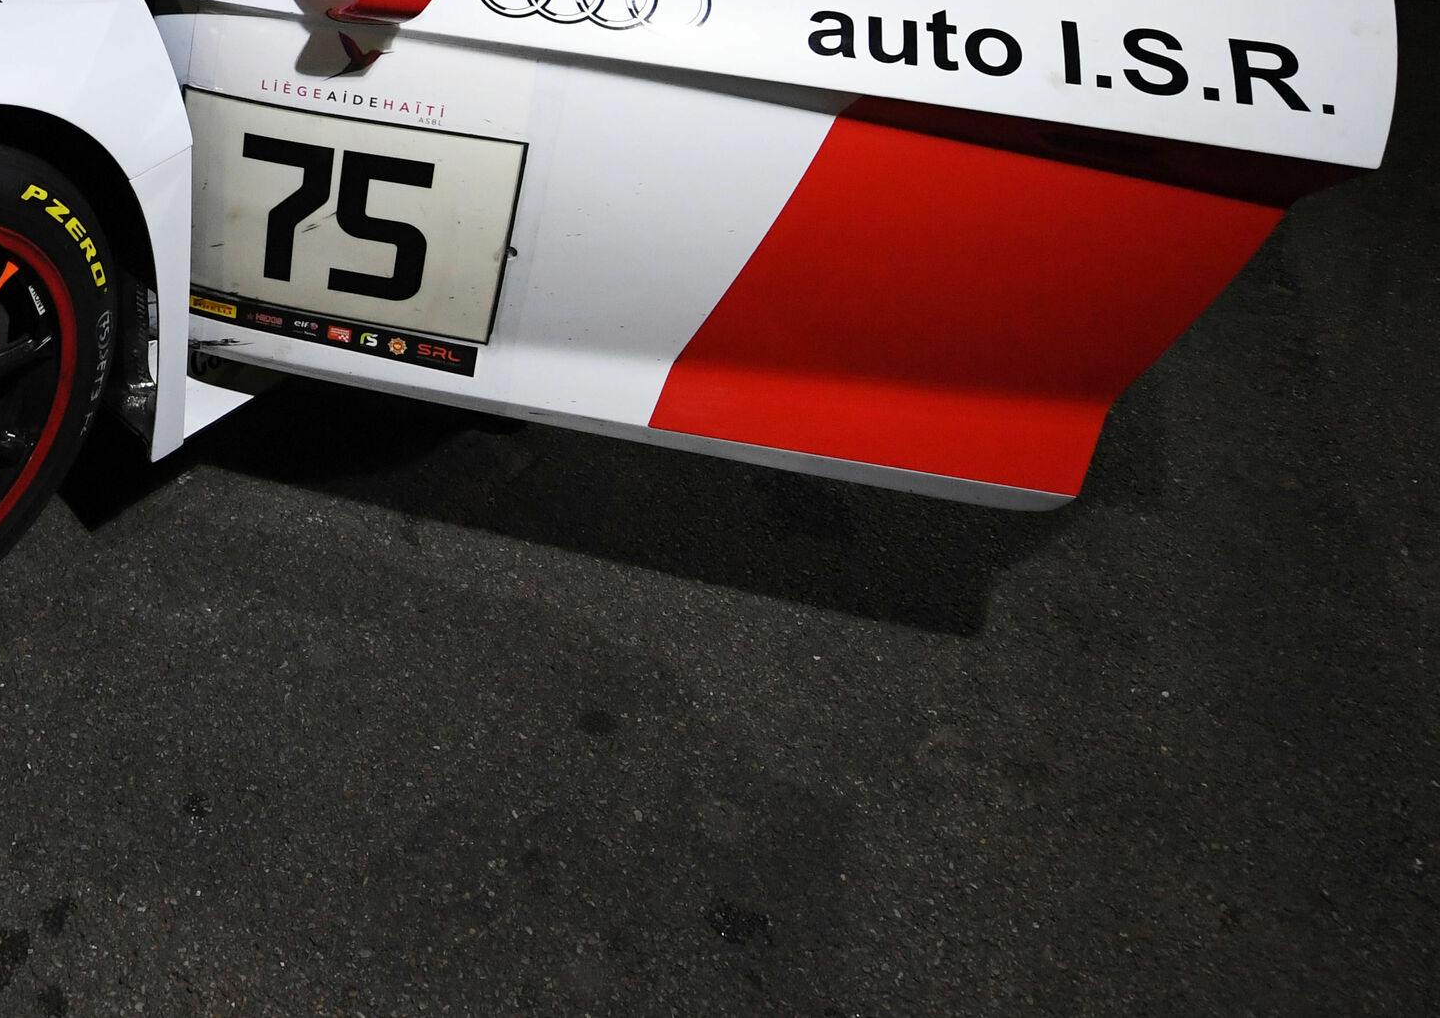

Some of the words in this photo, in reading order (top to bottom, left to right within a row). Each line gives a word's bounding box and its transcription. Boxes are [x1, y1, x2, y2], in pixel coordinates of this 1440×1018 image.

[807, 9, 1023, 78] auto
[1060, 19, 1336, 115] I.S.R.
[418, 116, 443, 127] ASBL
[242, 132, 436, 302] 75
[192, 297, 235, 316] PIRELLI
[417, 343, 461, 363] SRL
